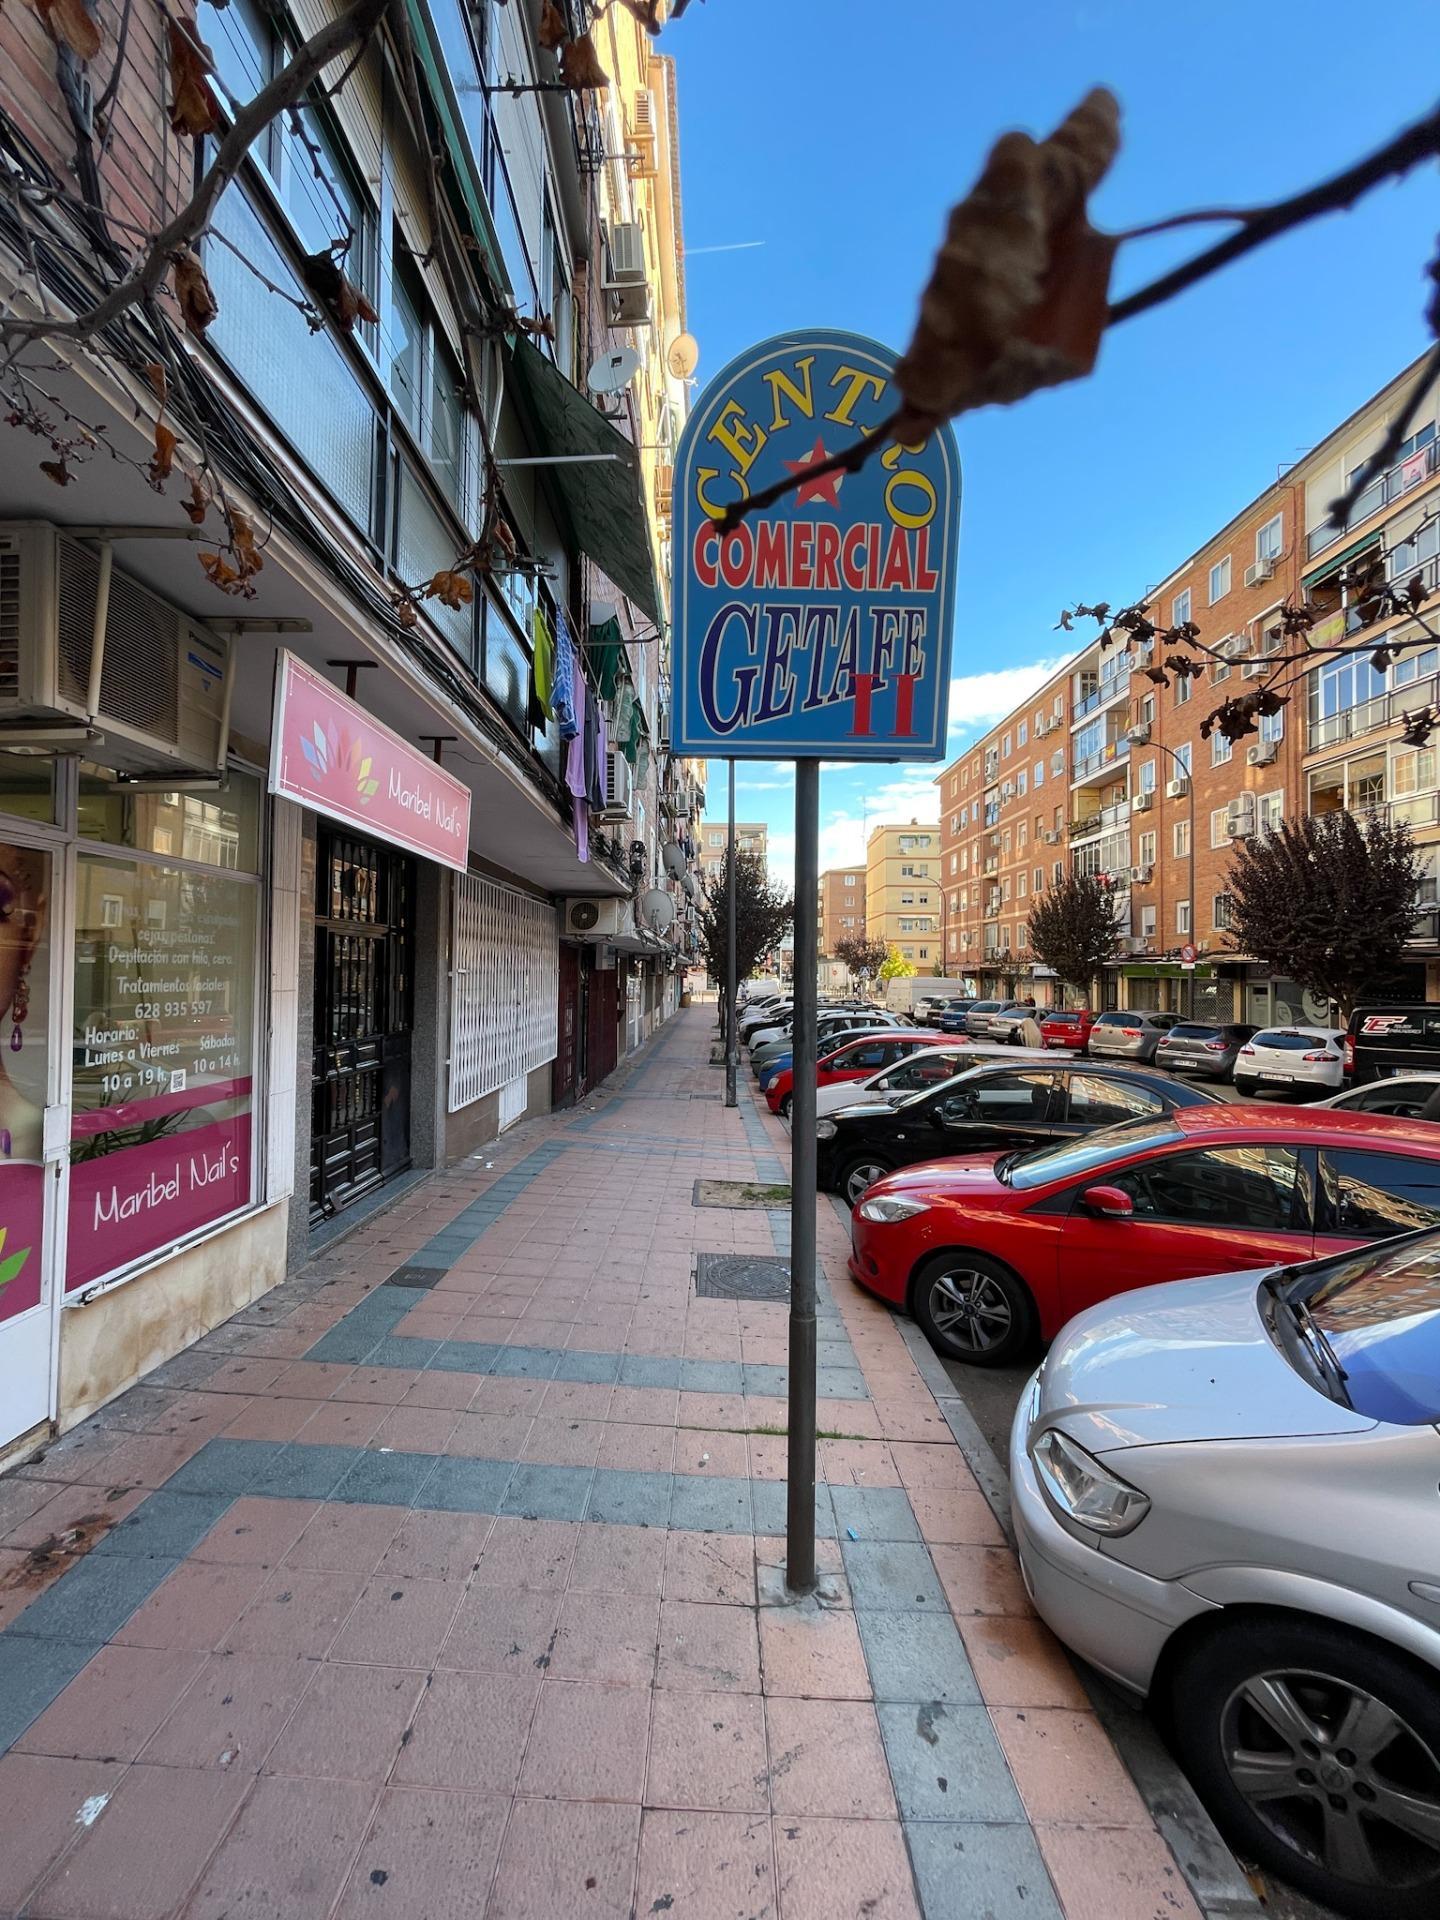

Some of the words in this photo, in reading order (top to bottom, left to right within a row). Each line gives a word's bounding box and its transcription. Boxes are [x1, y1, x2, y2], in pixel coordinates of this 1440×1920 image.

[693, 520, 940, 593] COMERCIAL
[699, 601, 928, 736] GETAFE
[845, 673, 920, 737] II
[388, 767, 432, 820] Maribel
[108, 946, 168, 969] Depilación
[172, 953, 190, 964] con
[116, 976, 188, 995] Tratamientos
[135, 1003, 160, 1019] 628
[164, 1001, 187, 1017] 935
[191, 1000, 212, 1015] 597
[85, 1026, 139, 1045] Horario:
[200, 1033, 236, 1051] Sábados
[85, 1049, 124, 1067] Lunes
[127, 1049, 136, 1061] a
[139, 1042, 180, 1059] Viernes
[193, 1058, 207, 1074] 10
[209, 1060, 216, 1071] a
[219, 1055, 231, 1069] 14
[101, 1073, 121, 1093] 10
[124, 1076, 133, 1088] a
[137, 1069, 154, 1087] 19
[156, 1066, 167, 1083] h.
[93, 1162, 181, 1232] Maribel
